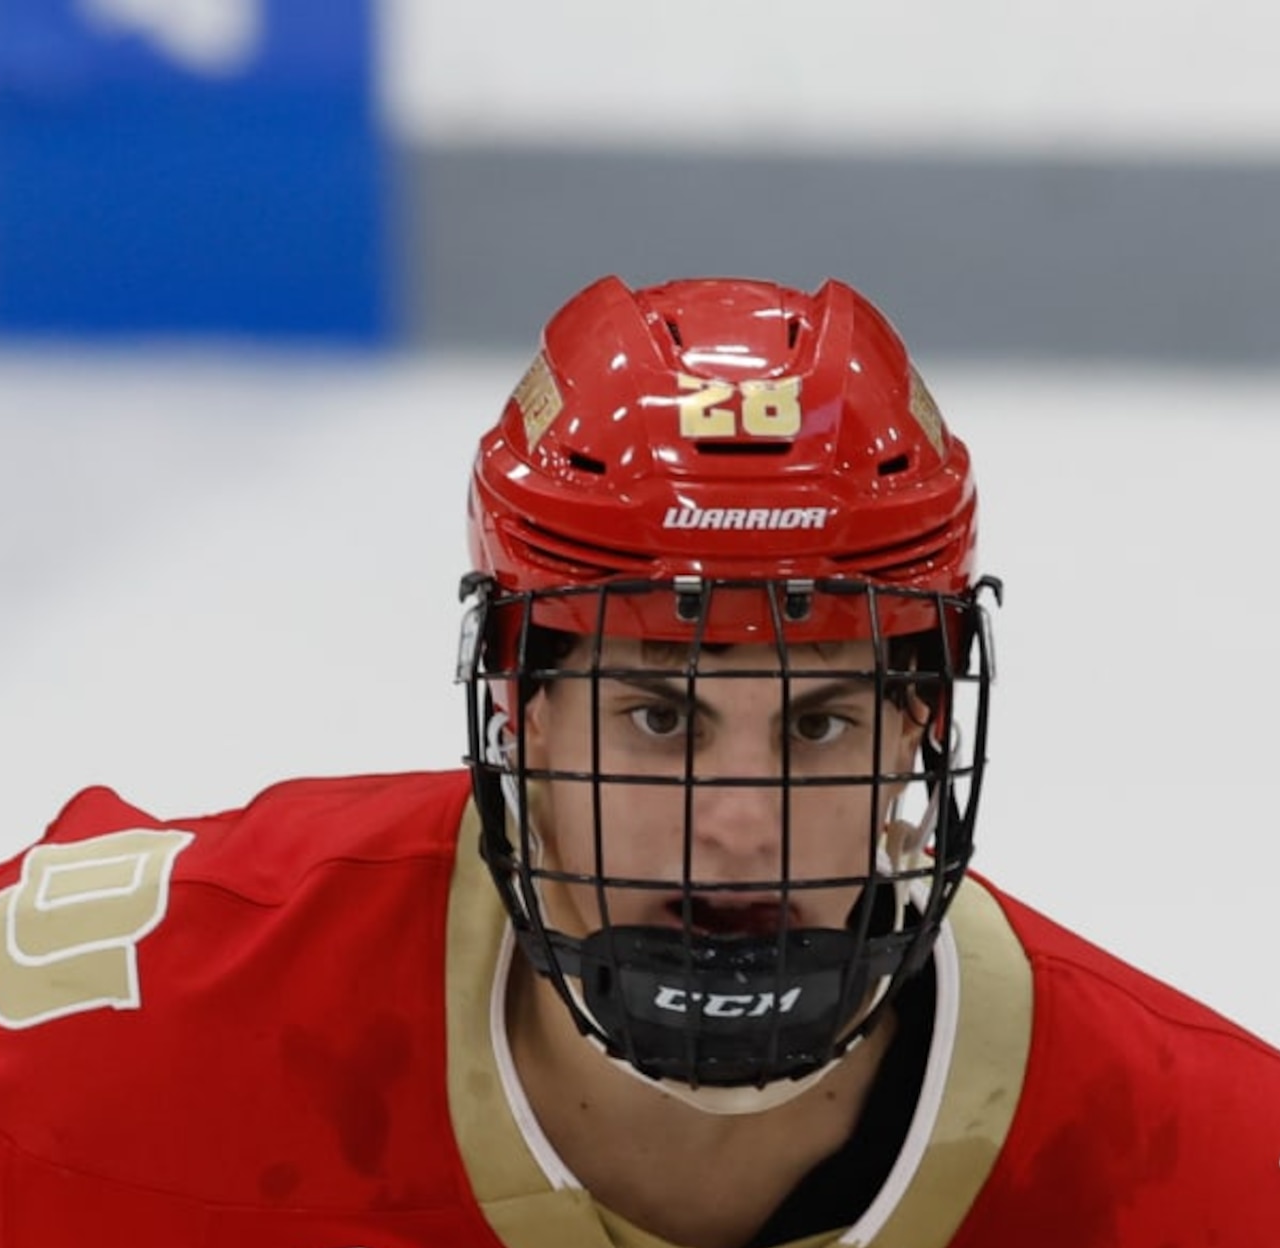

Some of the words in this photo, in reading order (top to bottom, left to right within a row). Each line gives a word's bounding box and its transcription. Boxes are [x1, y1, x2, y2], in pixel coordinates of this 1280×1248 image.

[677, 372, 803, 437] 28
[663, 507, 828, 530] WARRIOR
[654, 985, 803, 1018] CCM
